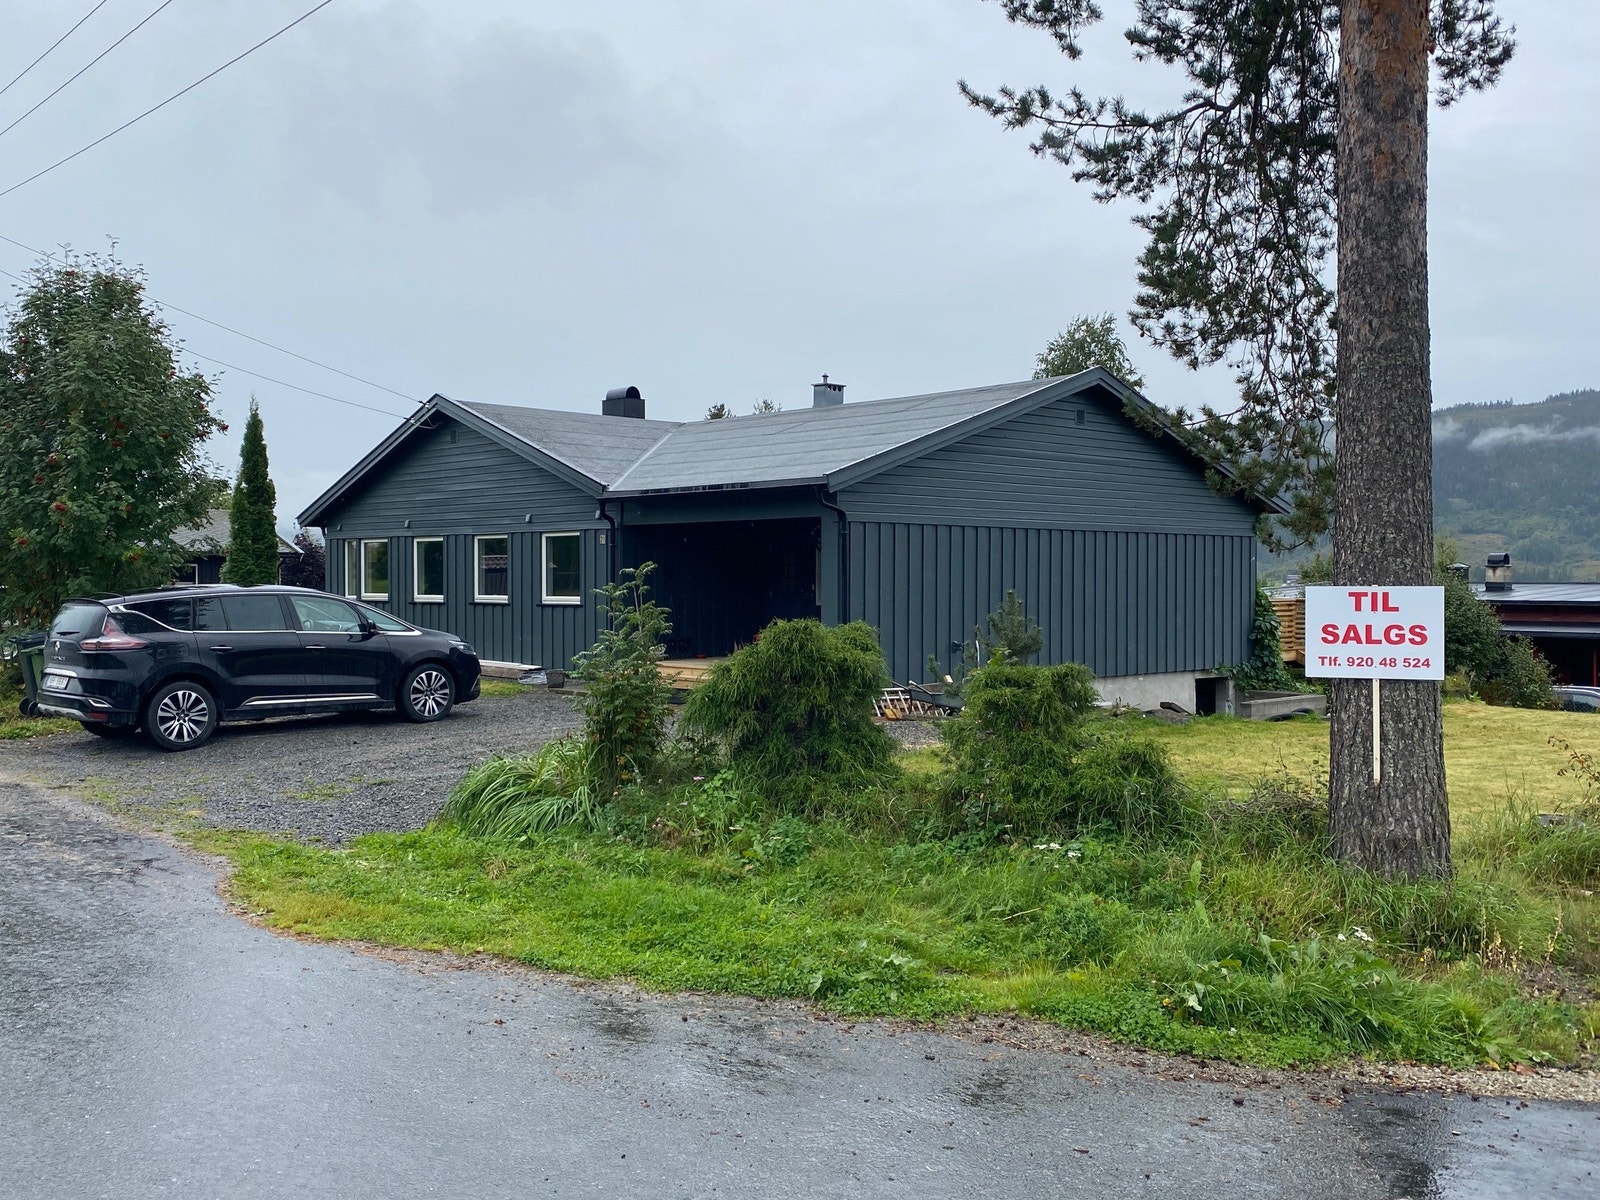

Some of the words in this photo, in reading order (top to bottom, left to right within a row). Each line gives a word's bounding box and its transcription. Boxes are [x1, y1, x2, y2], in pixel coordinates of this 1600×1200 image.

[1348, 591, 1399, 612] TIL
[1320, 624, 1428, 645] SALGS
[1318, 656, 1341, 667] Tlf.
[1346, 656, 1374, 667] 920
[1379, 657, 1397, 668] 48
[1402, 658, 1431, 668] 524
